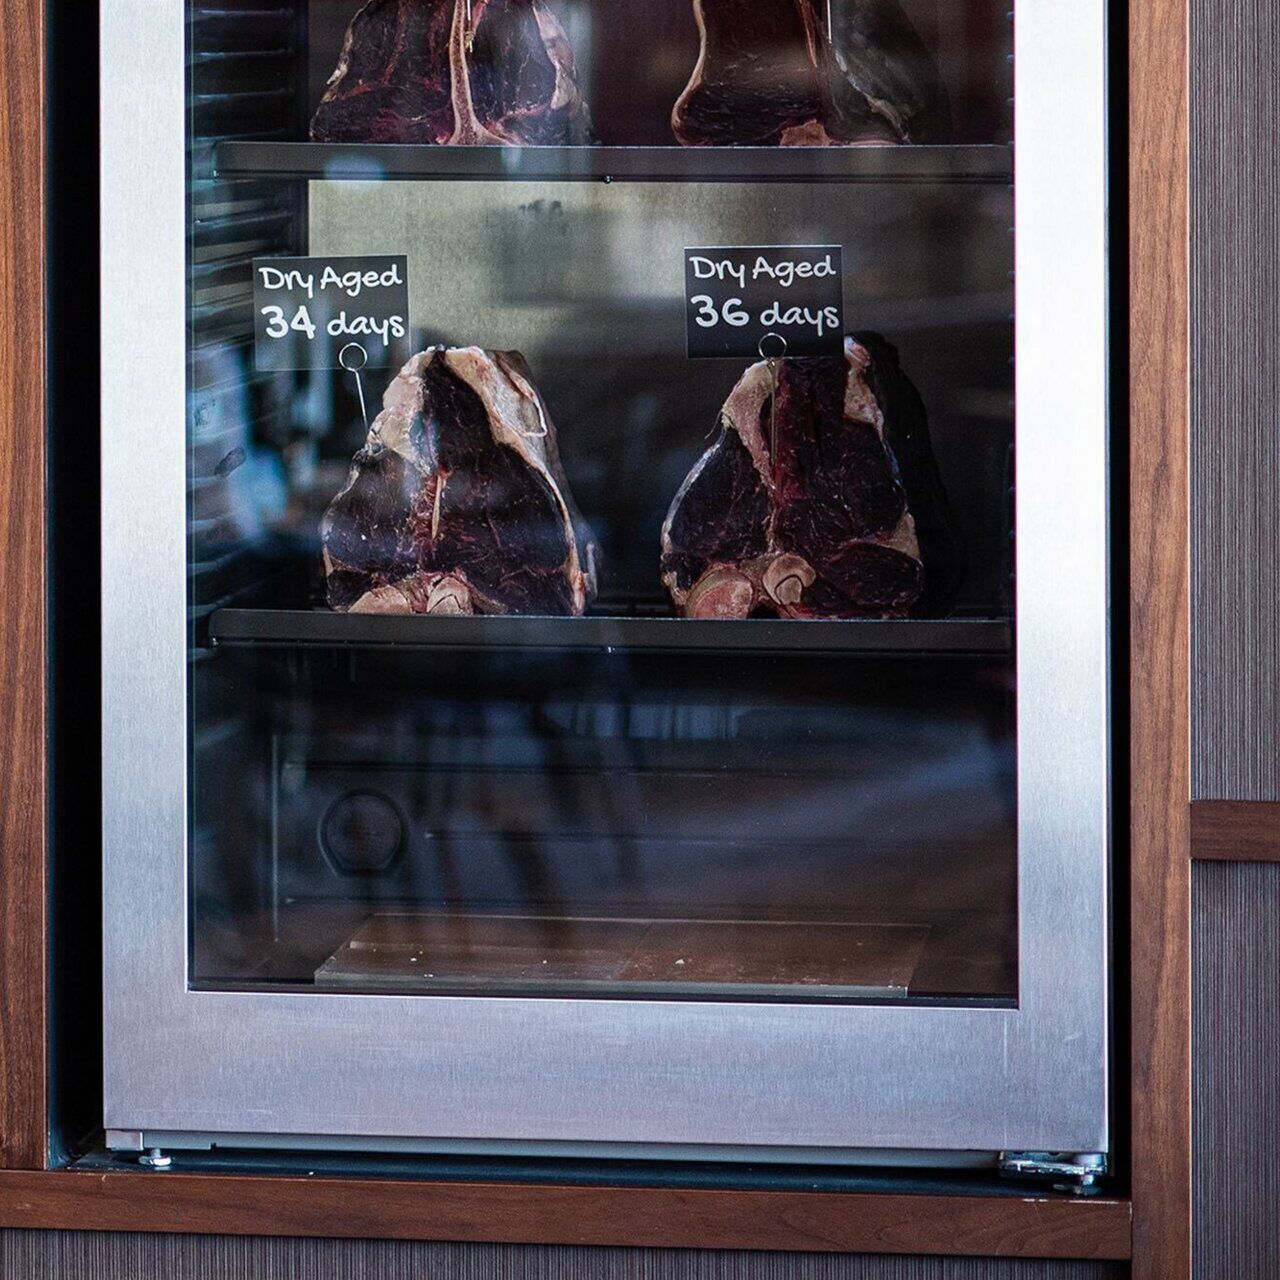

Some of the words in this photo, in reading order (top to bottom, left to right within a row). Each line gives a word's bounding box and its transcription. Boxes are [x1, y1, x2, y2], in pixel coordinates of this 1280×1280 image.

[259, 268, 313, 298] Dry
[321, 264, 402, 296] Aged
[689, 257, 745, 288] Dry
[753, 255, 836, 286] Aged
[261, 306, 316, 339] 34
[326, 311, 405, 348] days
[691, 295, 749, 327] 36
[759, 300, 840, 336] days
